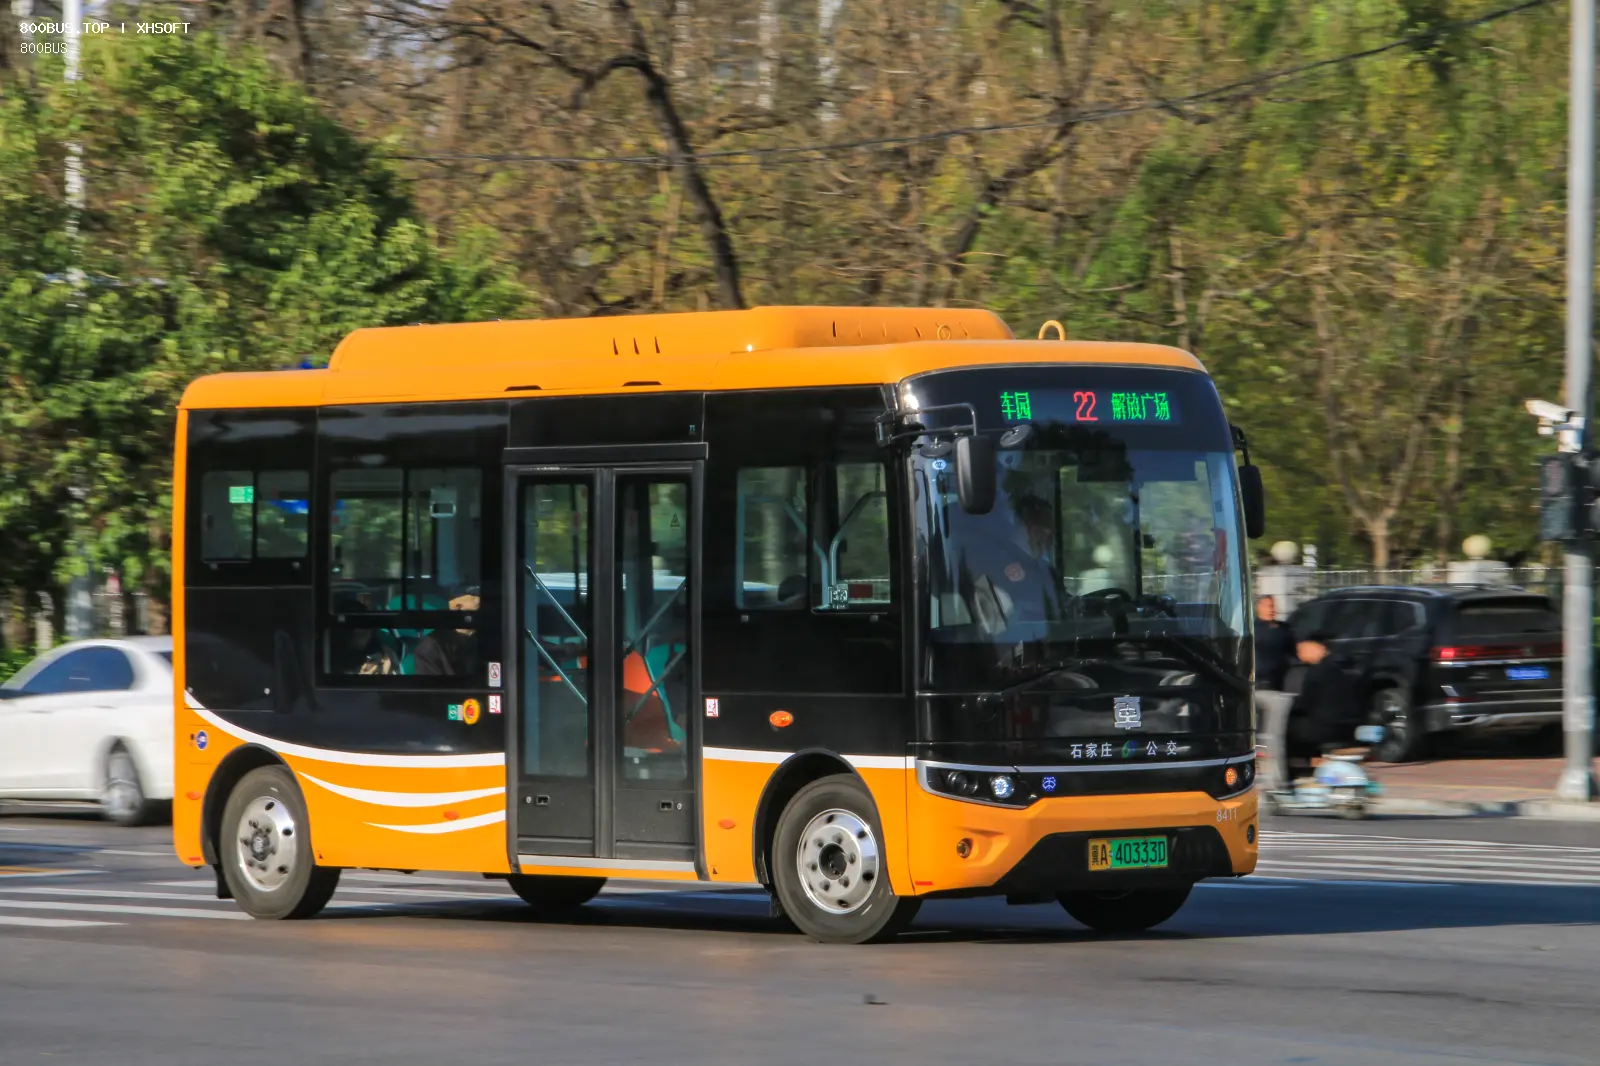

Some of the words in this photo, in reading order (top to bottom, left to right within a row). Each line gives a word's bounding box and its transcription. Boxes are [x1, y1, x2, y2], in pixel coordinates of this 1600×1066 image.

[1073, 391, 1098, 421] 22
[1111, 391, 1170, 420] 解放广场
[1070, 742, 1113, 759] 石家庄
[1146, 740, 1177, 756] 公交
[1216, 808, 1237, 823] 8411
